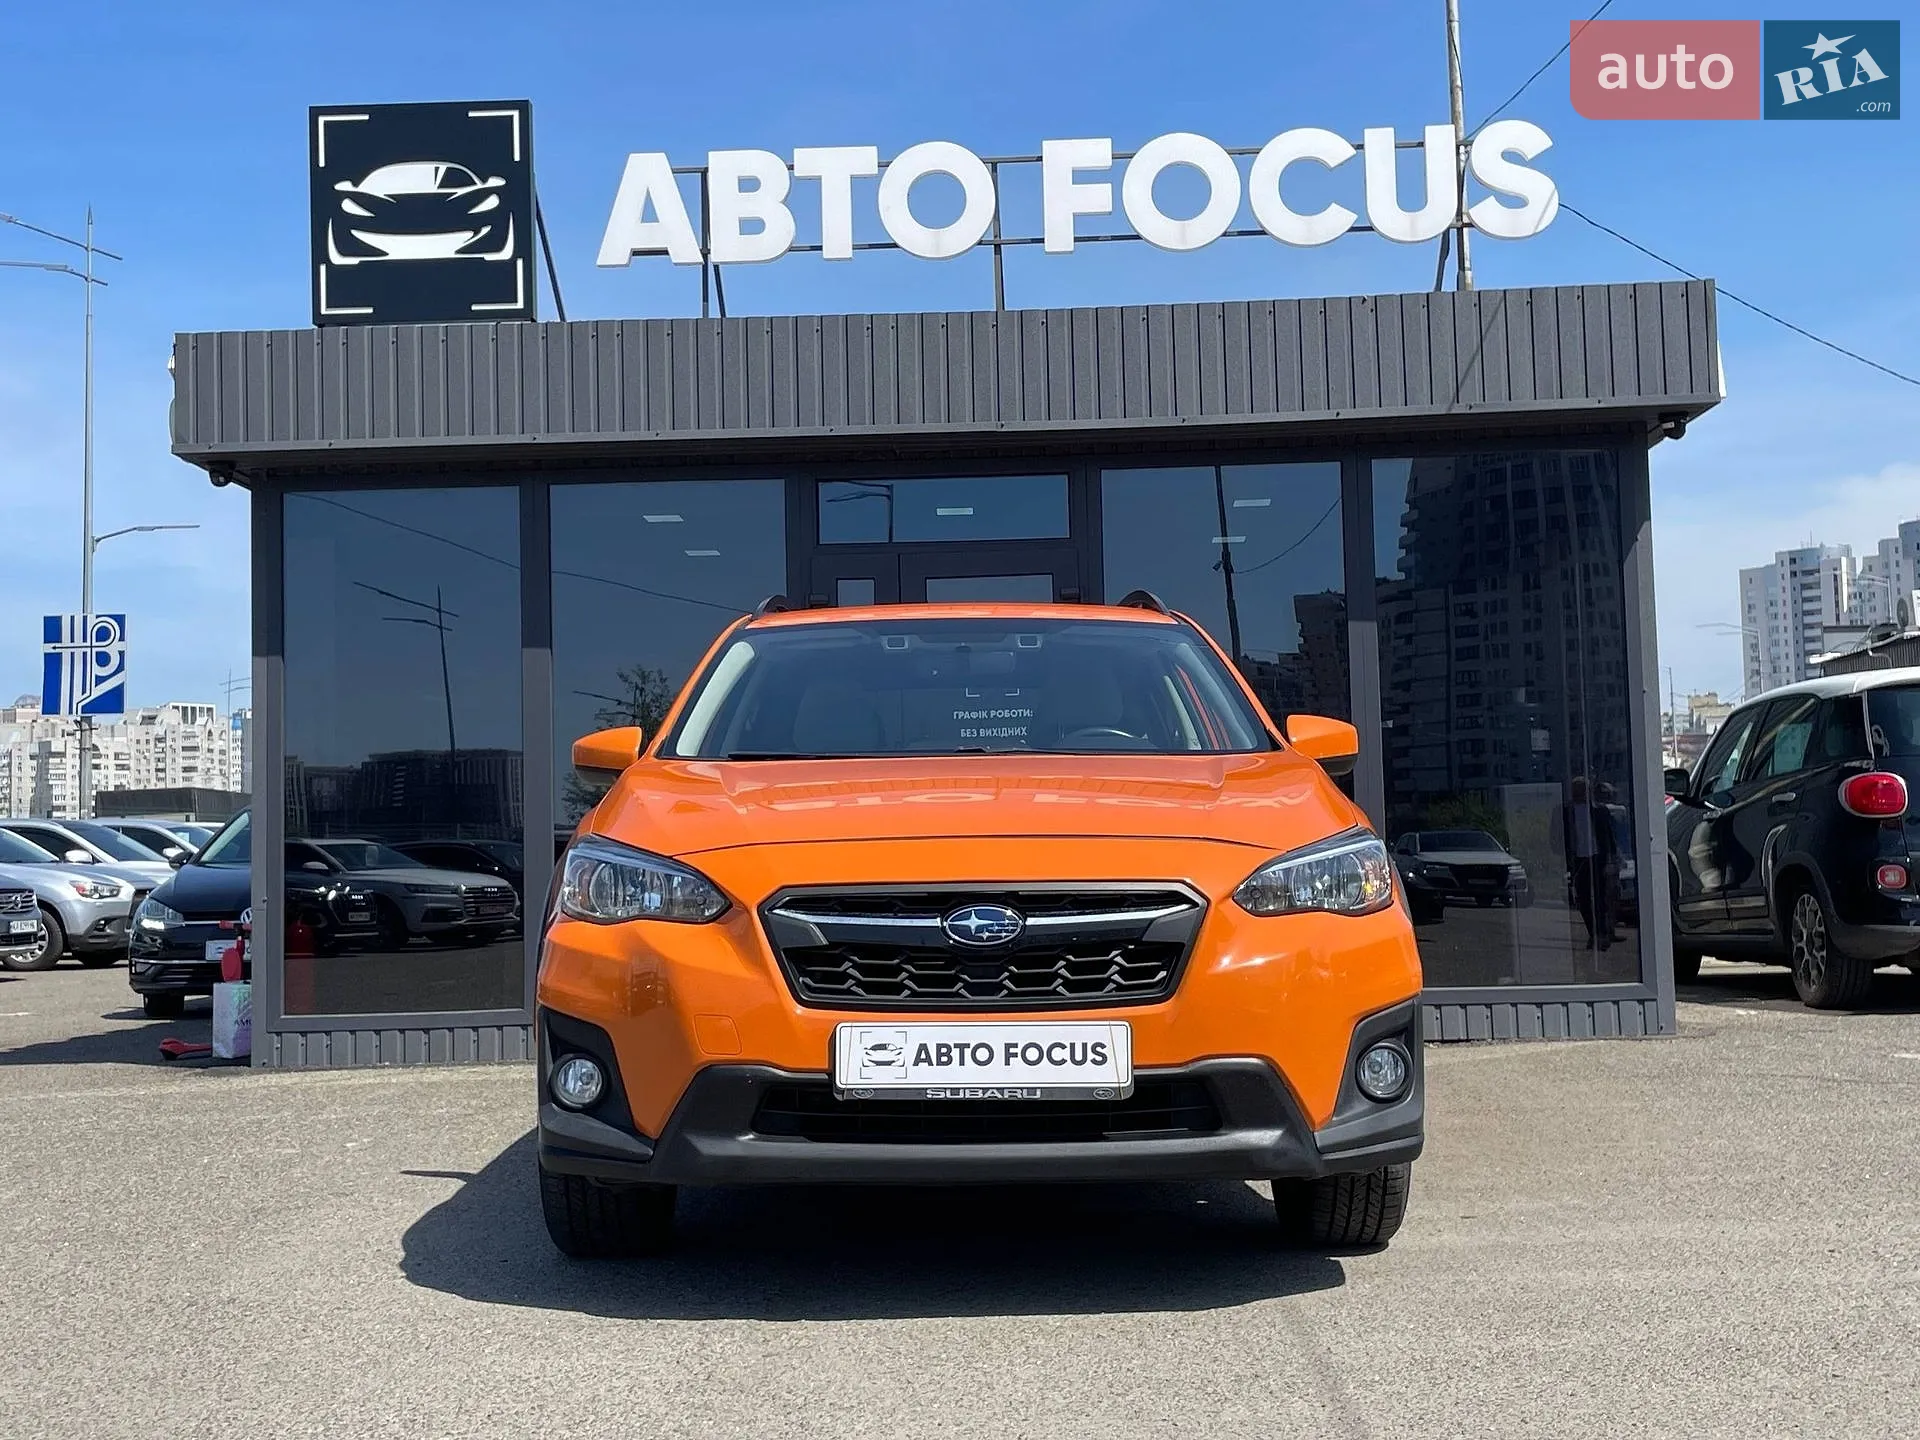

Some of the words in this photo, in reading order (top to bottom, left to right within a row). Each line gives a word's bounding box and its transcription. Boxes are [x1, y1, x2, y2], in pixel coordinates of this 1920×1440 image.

[1041, 119, 1559, 254] FOCUS
[953, 709, 989, 720] ГРАФІК
[990, 708, 1033, 719] РОБОТИ:
[960, 728, 978, 738] БЕЗ
[979, 726, 1028, 738] ВИХІДНИХ
[1004, 1042, 1108, 1067] FOCUS
[926, 1088, 1042, 1099] SUBARU
